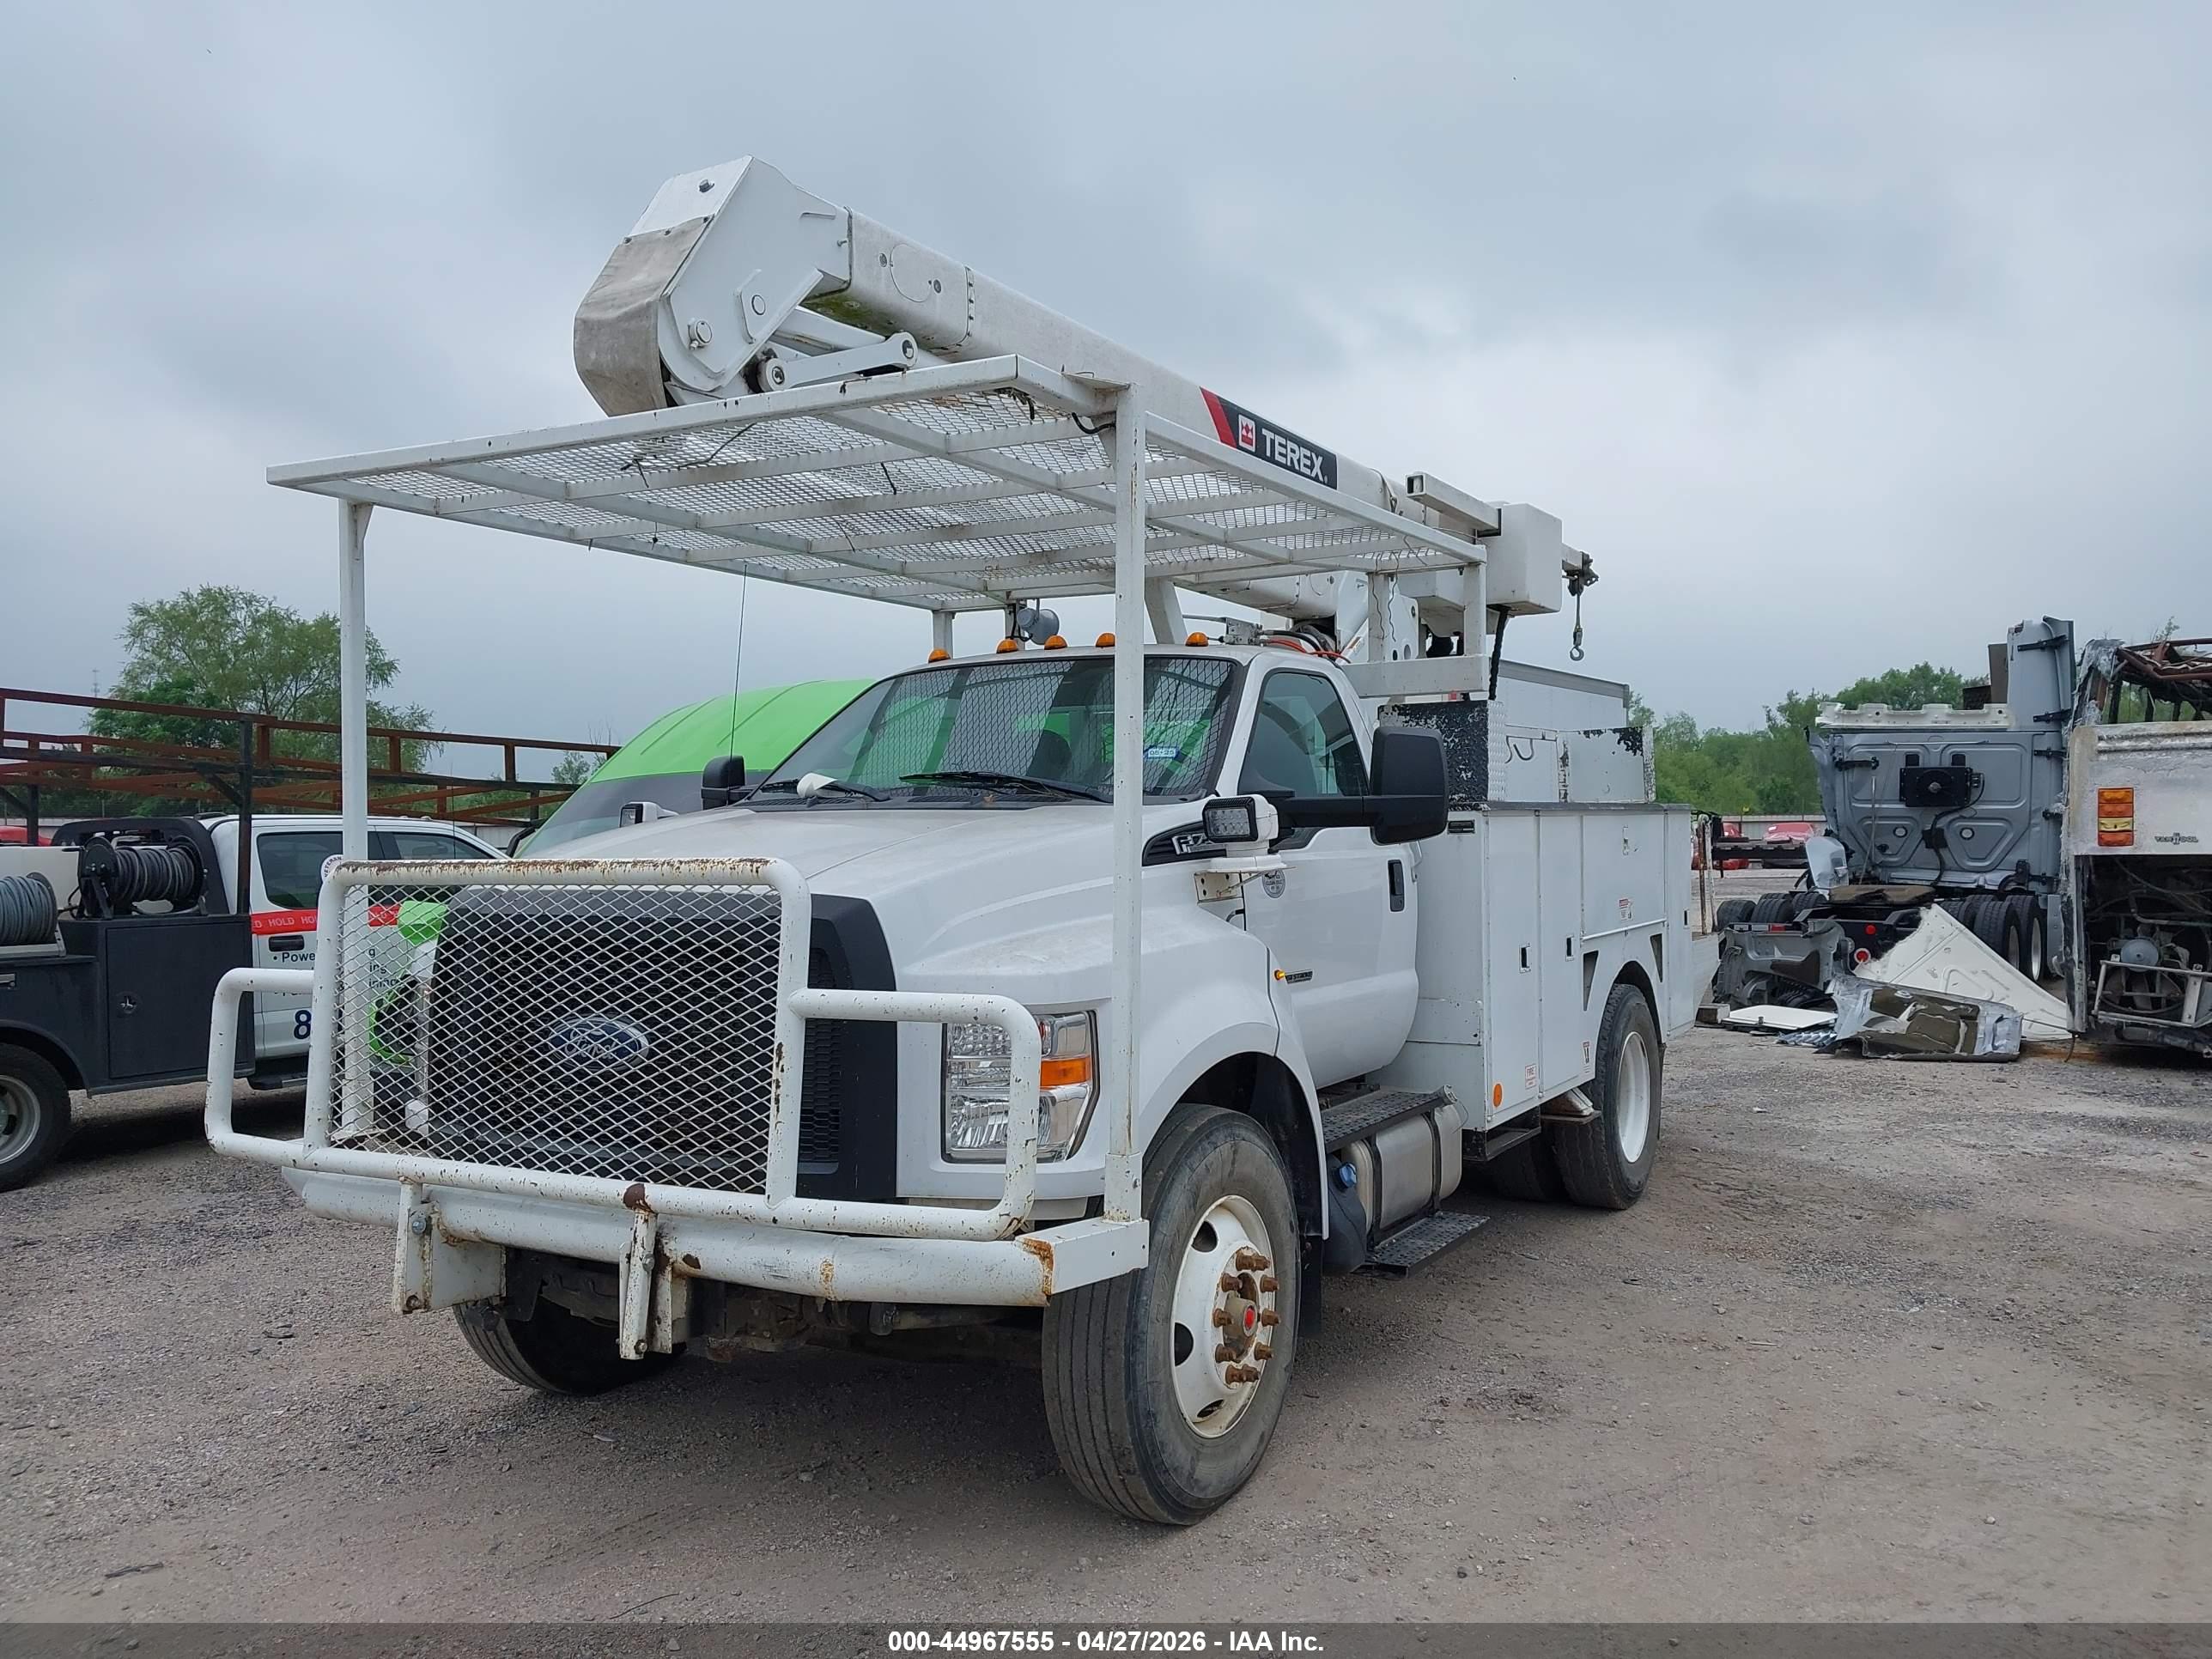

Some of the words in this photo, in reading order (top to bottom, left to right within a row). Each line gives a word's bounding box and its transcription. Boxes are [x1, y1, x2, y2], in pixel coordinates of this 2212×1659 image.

[1261, 428, 1324, 483] TEREX
[268, 917, 295, 927] HOLD
[294, 1010, 311, 1040] 8
